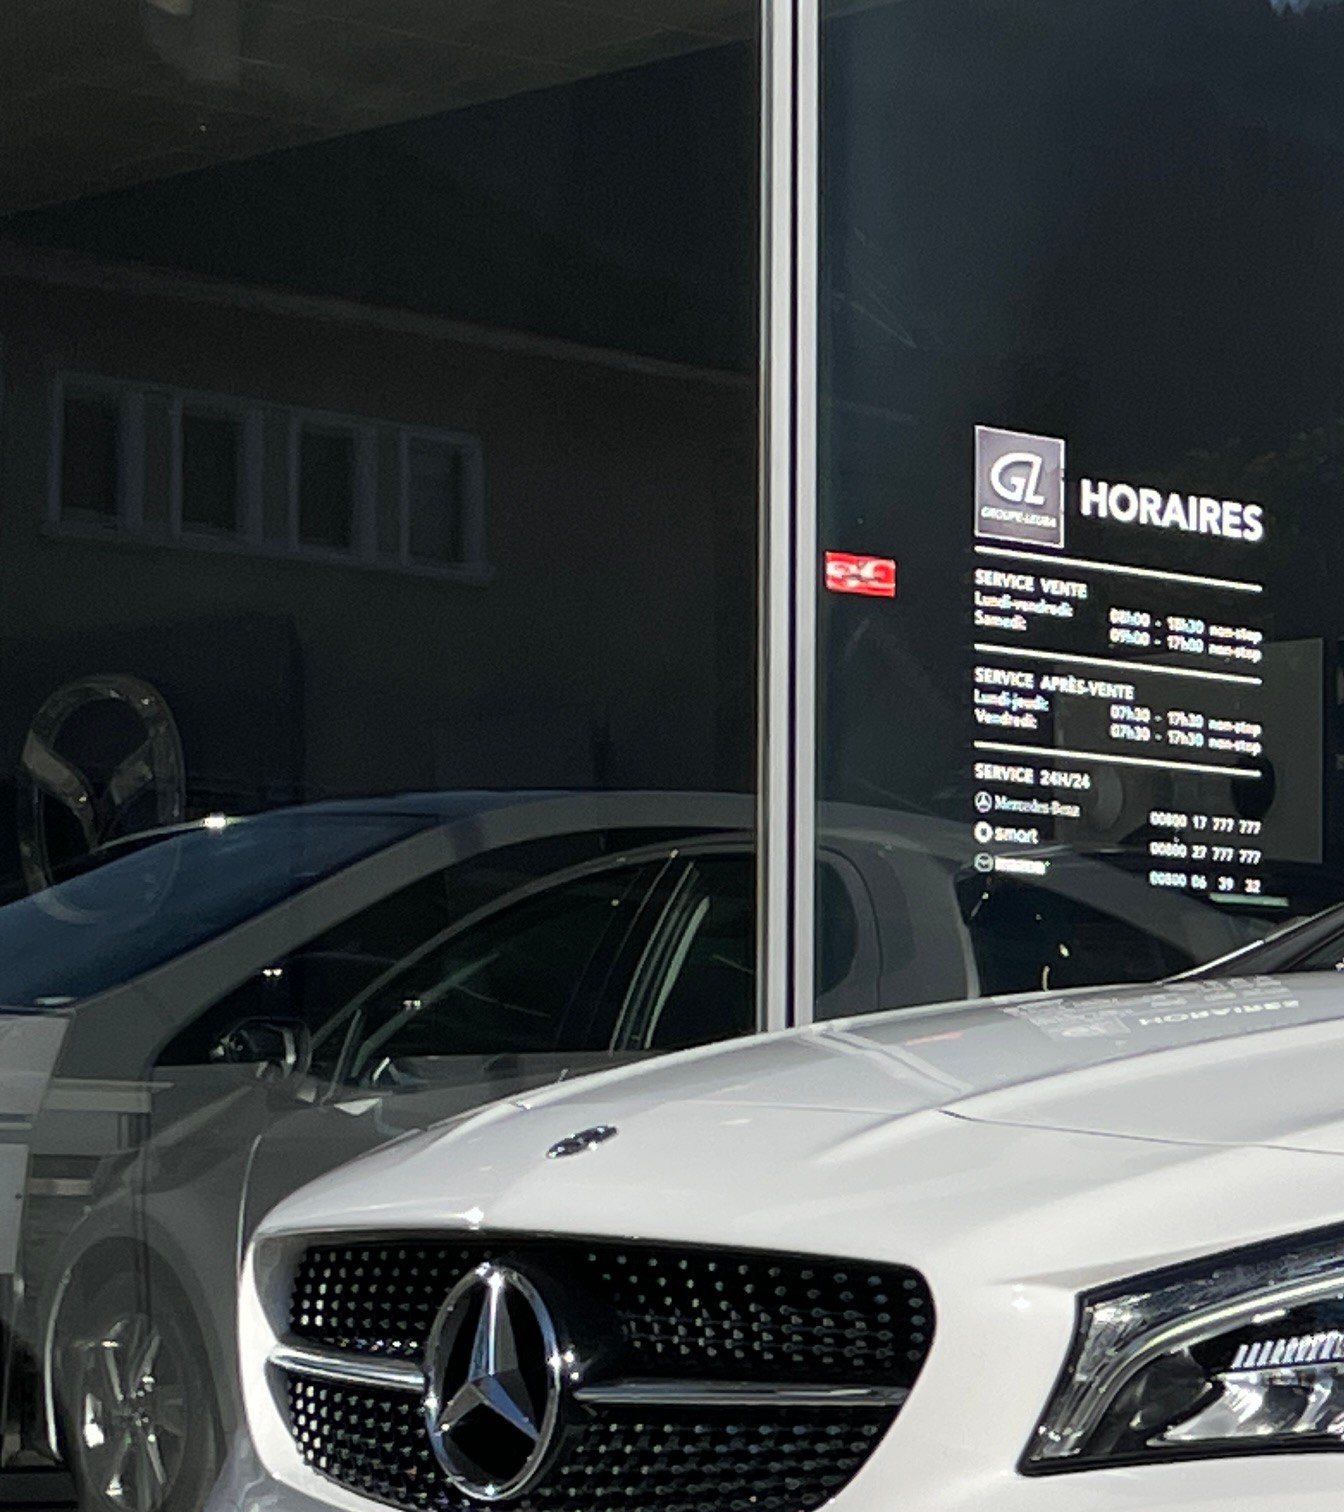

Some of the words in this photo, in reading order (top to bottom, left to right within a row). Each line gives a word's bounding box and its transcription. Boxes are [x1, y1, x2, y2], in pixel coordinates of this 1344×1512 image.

[990, 452, 1046, 505] GL
[1080, 477, 1264, 541] HORAIRES
[974, 568, 1035, 592] SERVICE
[1040, 578, 1088, 599] VENTE
[1209, 624, 1262, 645] non-stop
[1208, 643, 1262, 664] non-stop
[974, 666, 1035, 689] SERVICE
[1039, 674, 1135, 700] APRÈS-VENTE
[1208, 718, 1262, 738] non-stop
[1208, 737, 1262, 757] non-stop
[974, 762, 1035, 785] SERVICE
[1040, 769, 1091, 789] 24H/24
[994, 794, 1080, 817] Mercedes-Benz
[1192, 814, 1208, 830] 17
[1212, 816, 1235, 833] 777
[1239, 819, 1262, 835] 777
[994, 826, 1039, 845] smart
[1191, 844, 1208, 859] 27
[1211, 846, 1235, 862] 777
[1239, 848, 1262, 865] 777
